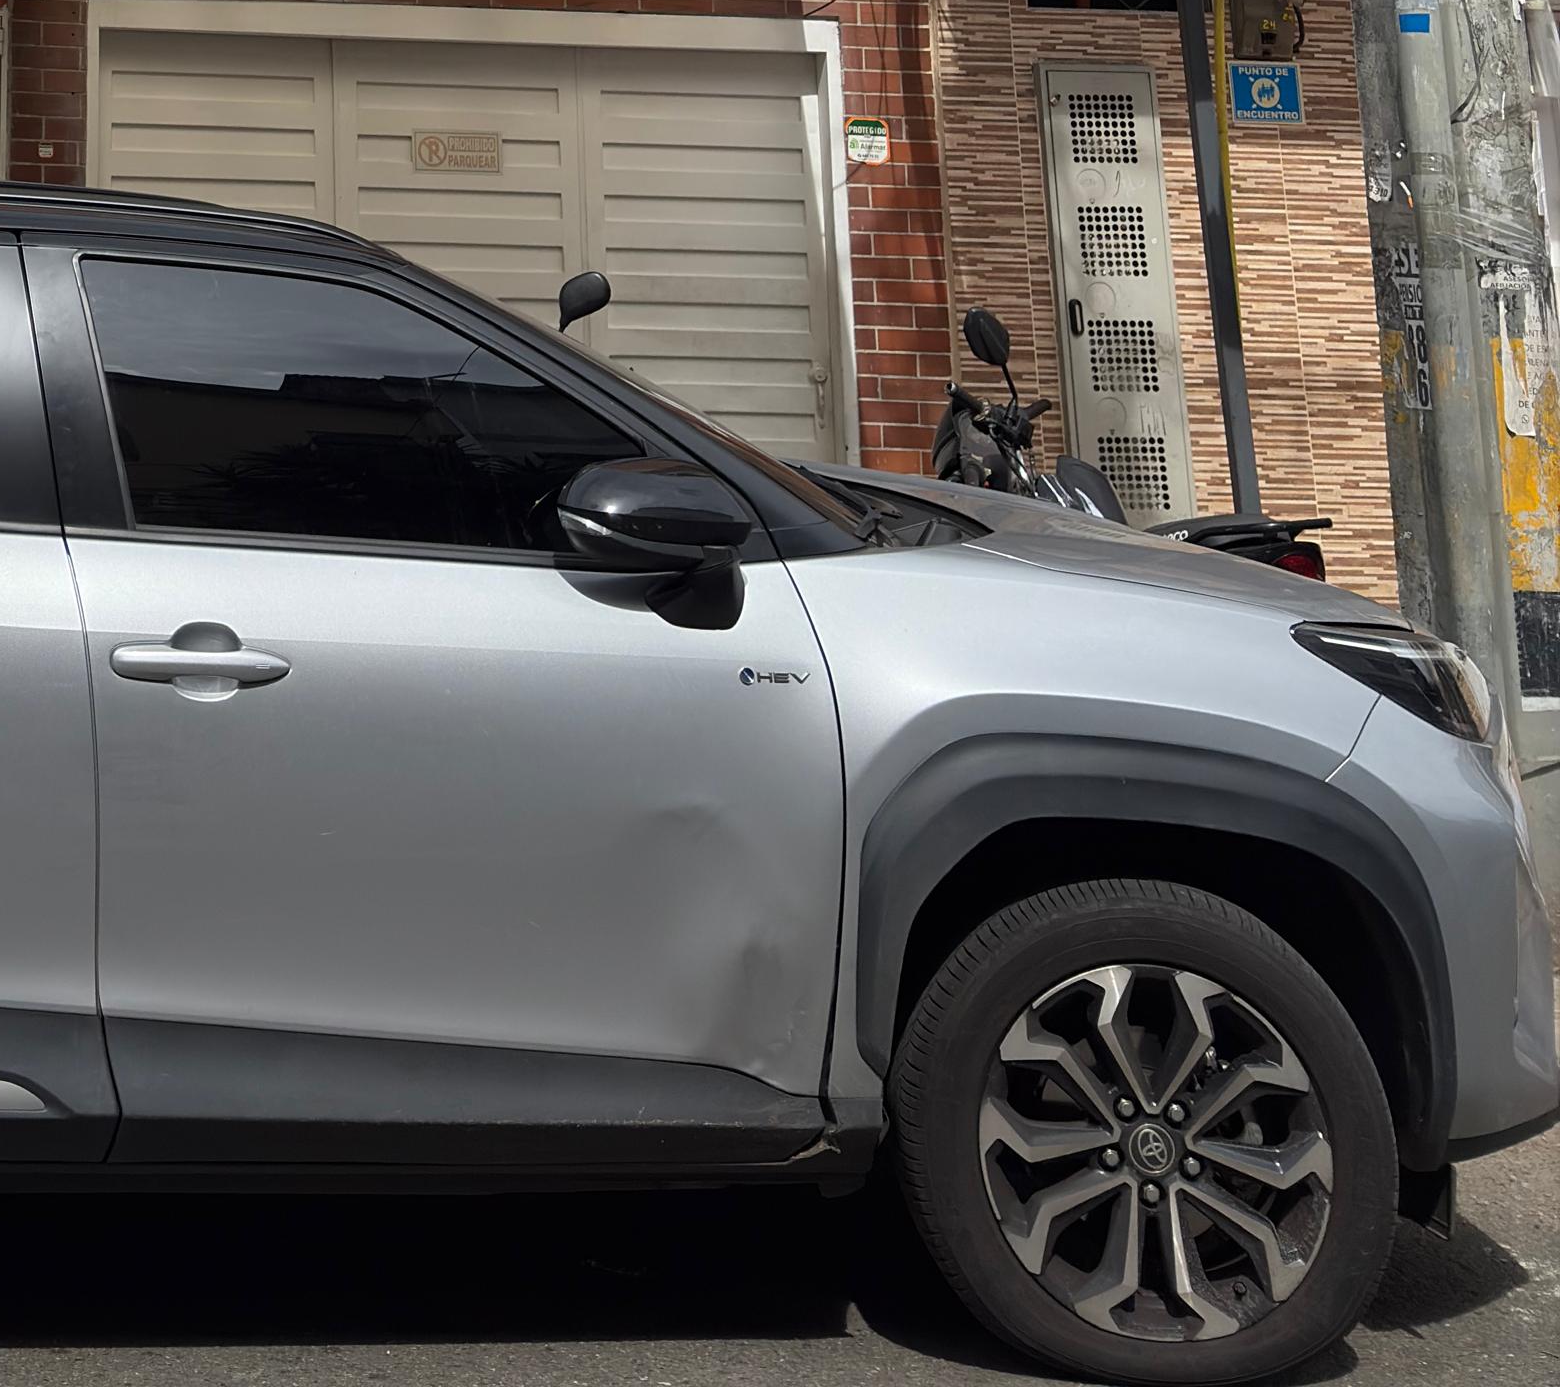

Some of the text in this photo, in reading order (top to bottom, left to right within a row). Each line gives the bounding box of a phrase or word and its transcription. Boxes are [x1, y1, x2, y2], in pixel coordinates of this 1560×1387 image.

[1238, 66, 1288, 76] PUNTO DE
[1237, 109, 1299, 119] ENCUENTRO
[848, 125, 887, 135] PROTEGIDO
[448, 137, 496, 152] PROHIBIDO
[448, 155, 497, 169] PARQUEAR
[756, 671, 811, 684] HEV
